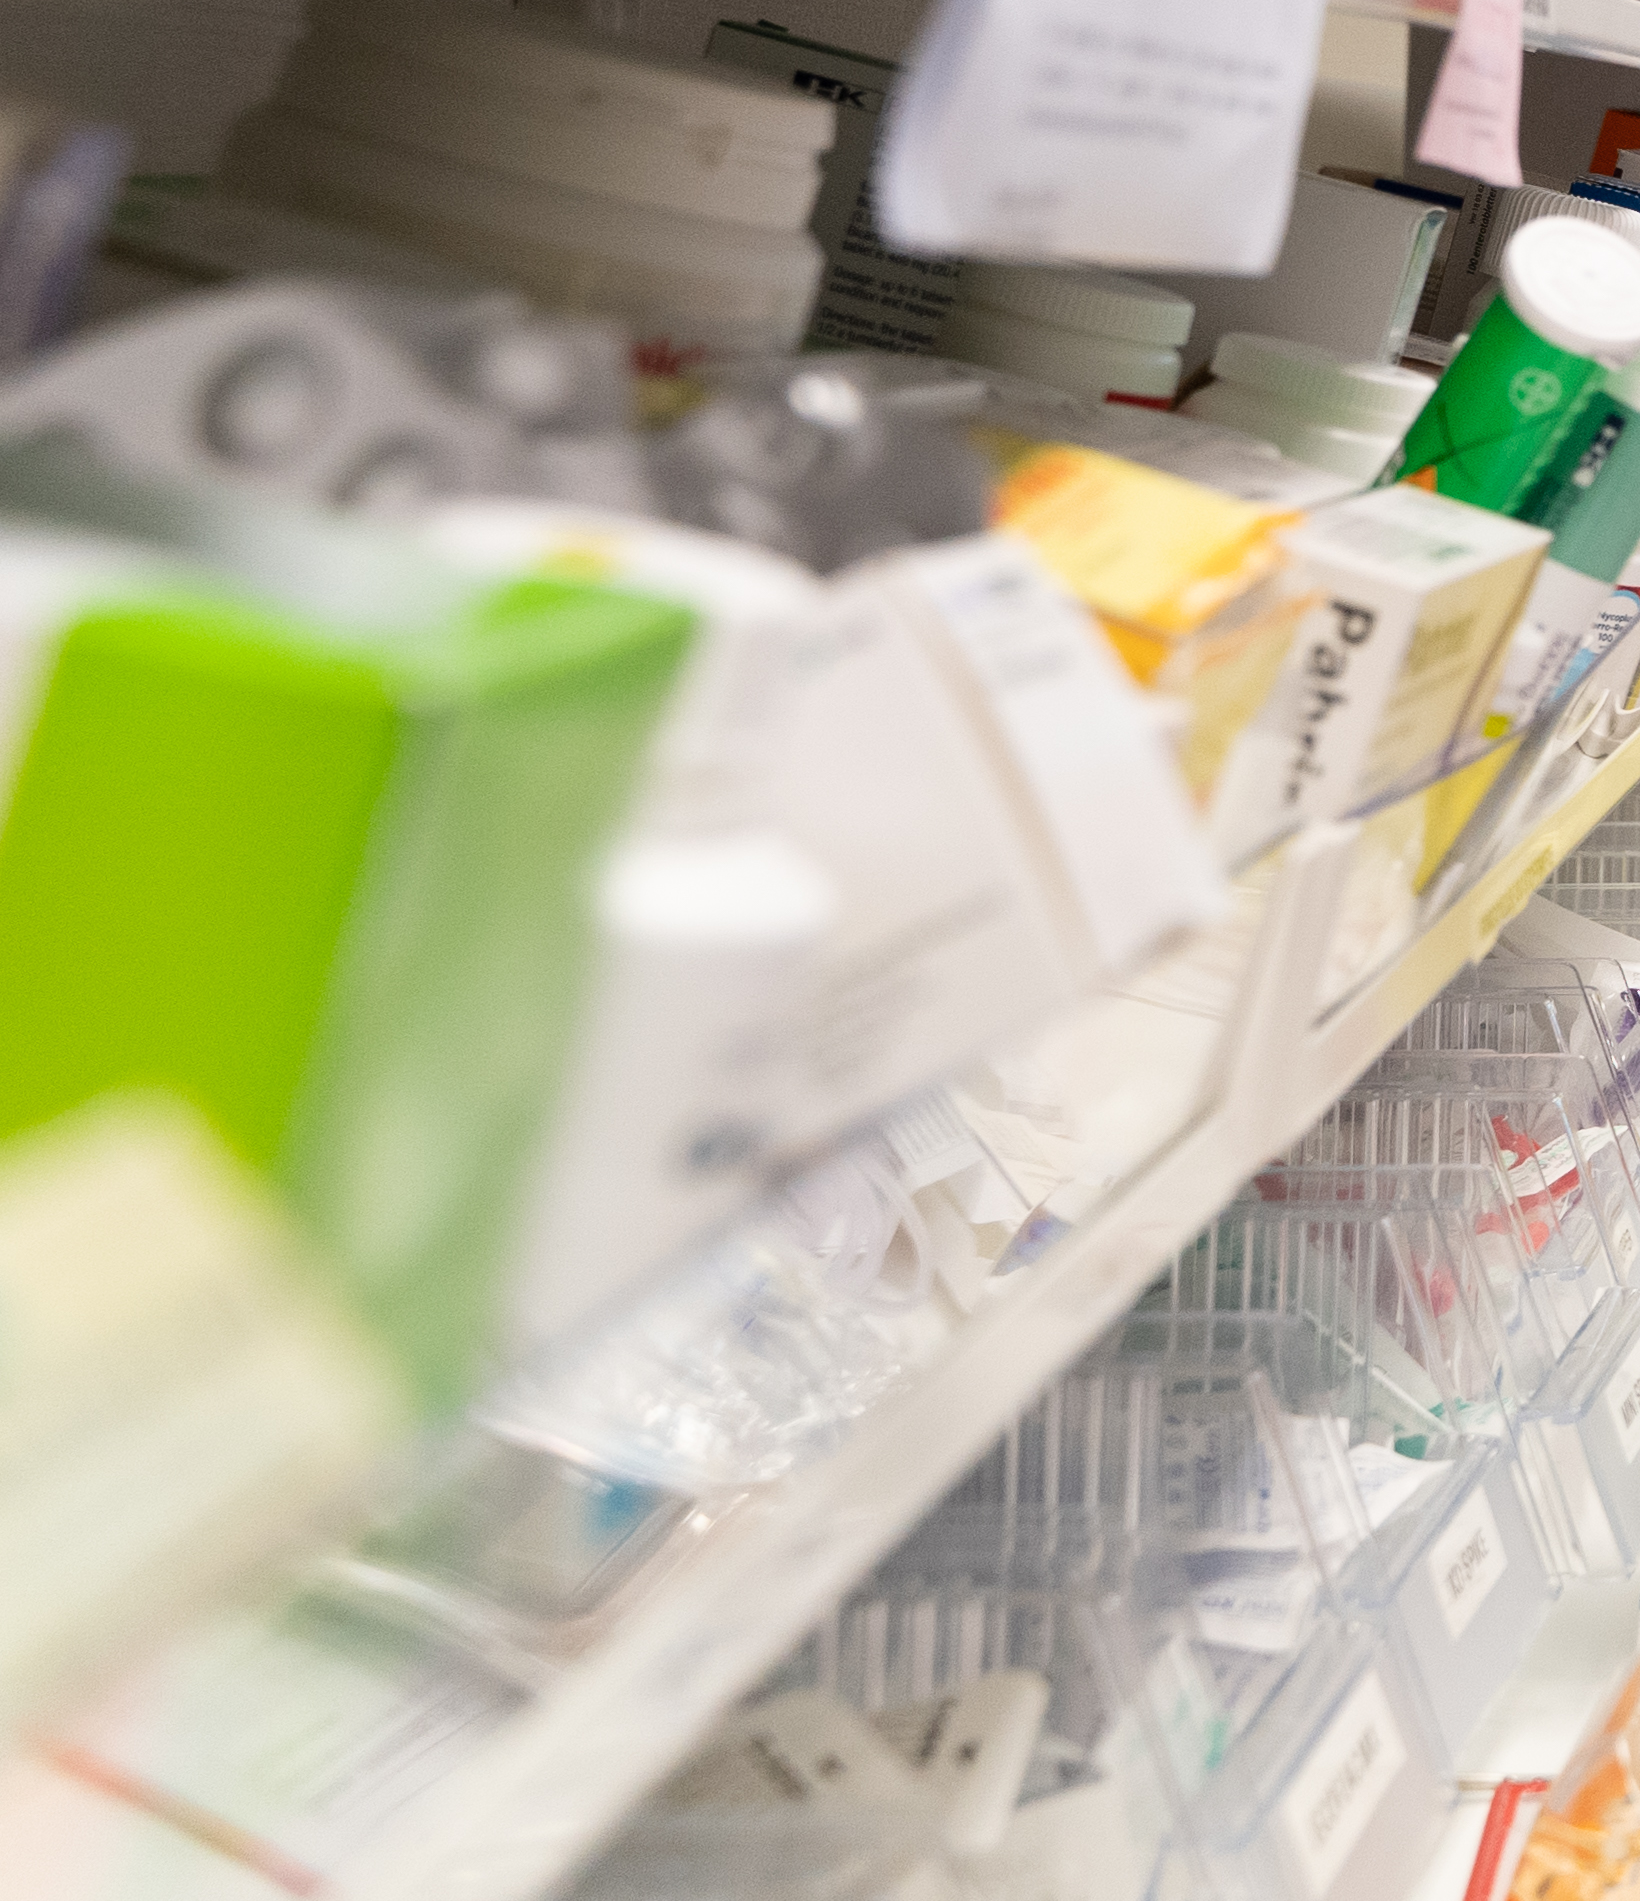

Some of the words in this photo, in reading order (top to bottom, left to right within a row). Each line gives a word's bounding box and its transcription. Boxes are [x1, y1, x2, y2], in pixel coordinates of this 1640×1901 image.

[1466, 256, 1478, 275] 100
[1475, 188, 1497, 258] enterotabletter
[1598, 632, 1614, 642] 100
